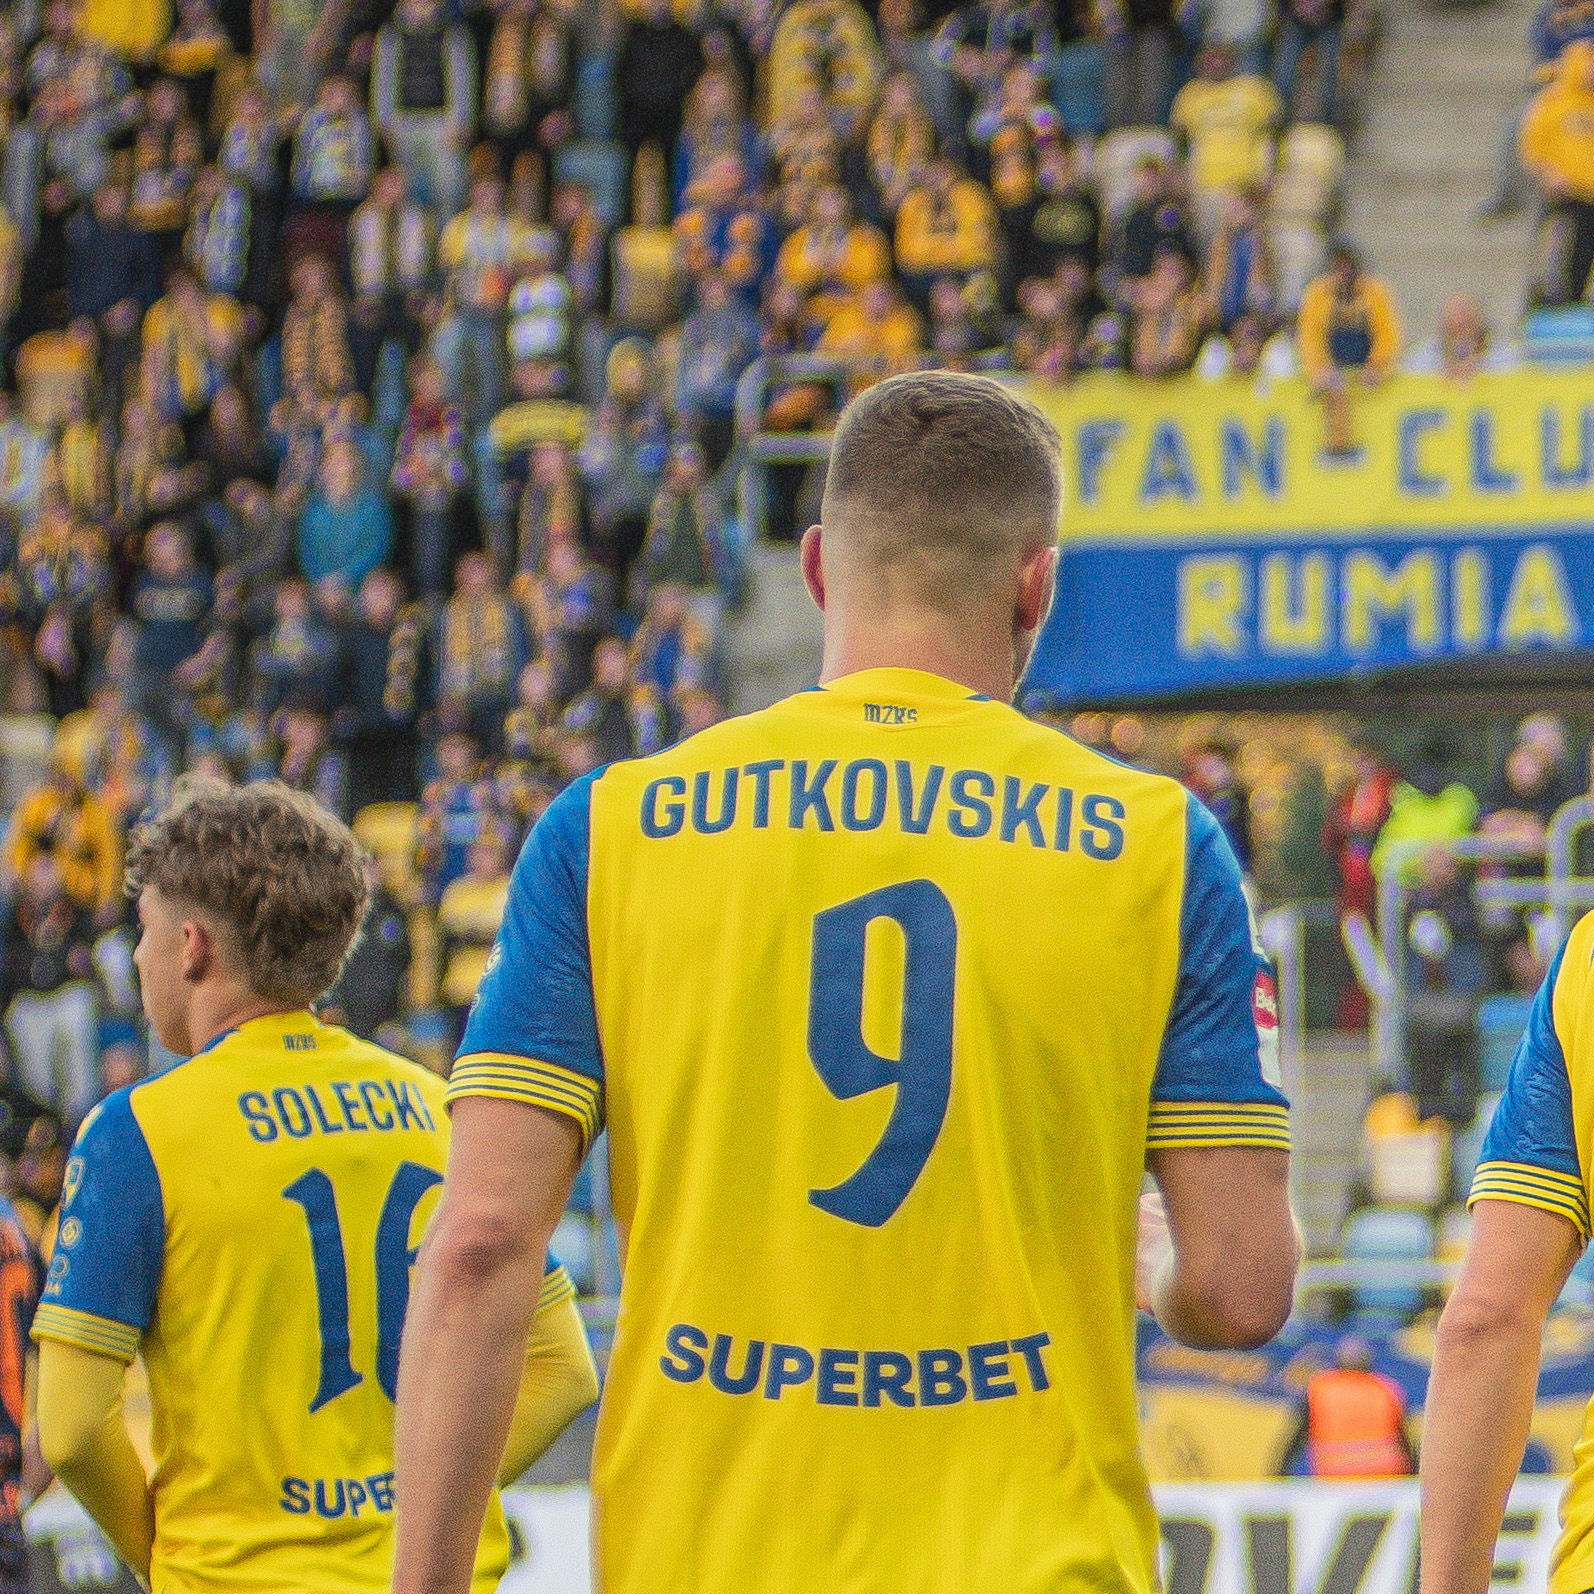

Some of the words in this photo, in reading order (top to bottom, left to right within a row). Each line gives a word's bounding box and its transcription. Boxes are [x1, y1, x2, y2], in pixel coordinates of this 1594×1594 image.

[1177, 546, 1579, 661] RUMIA
[864, 703, 918, 724] MZKS
[640, 757, 1126, 862] GUTKOVSKIS
[807, 878, 958, 1227] 9
[238, 1079, 437, 1144] SOLECKI
[659, 1324, 1055, 1408] SUPERBET
[279, 1472, 396, 1520] SUPE
